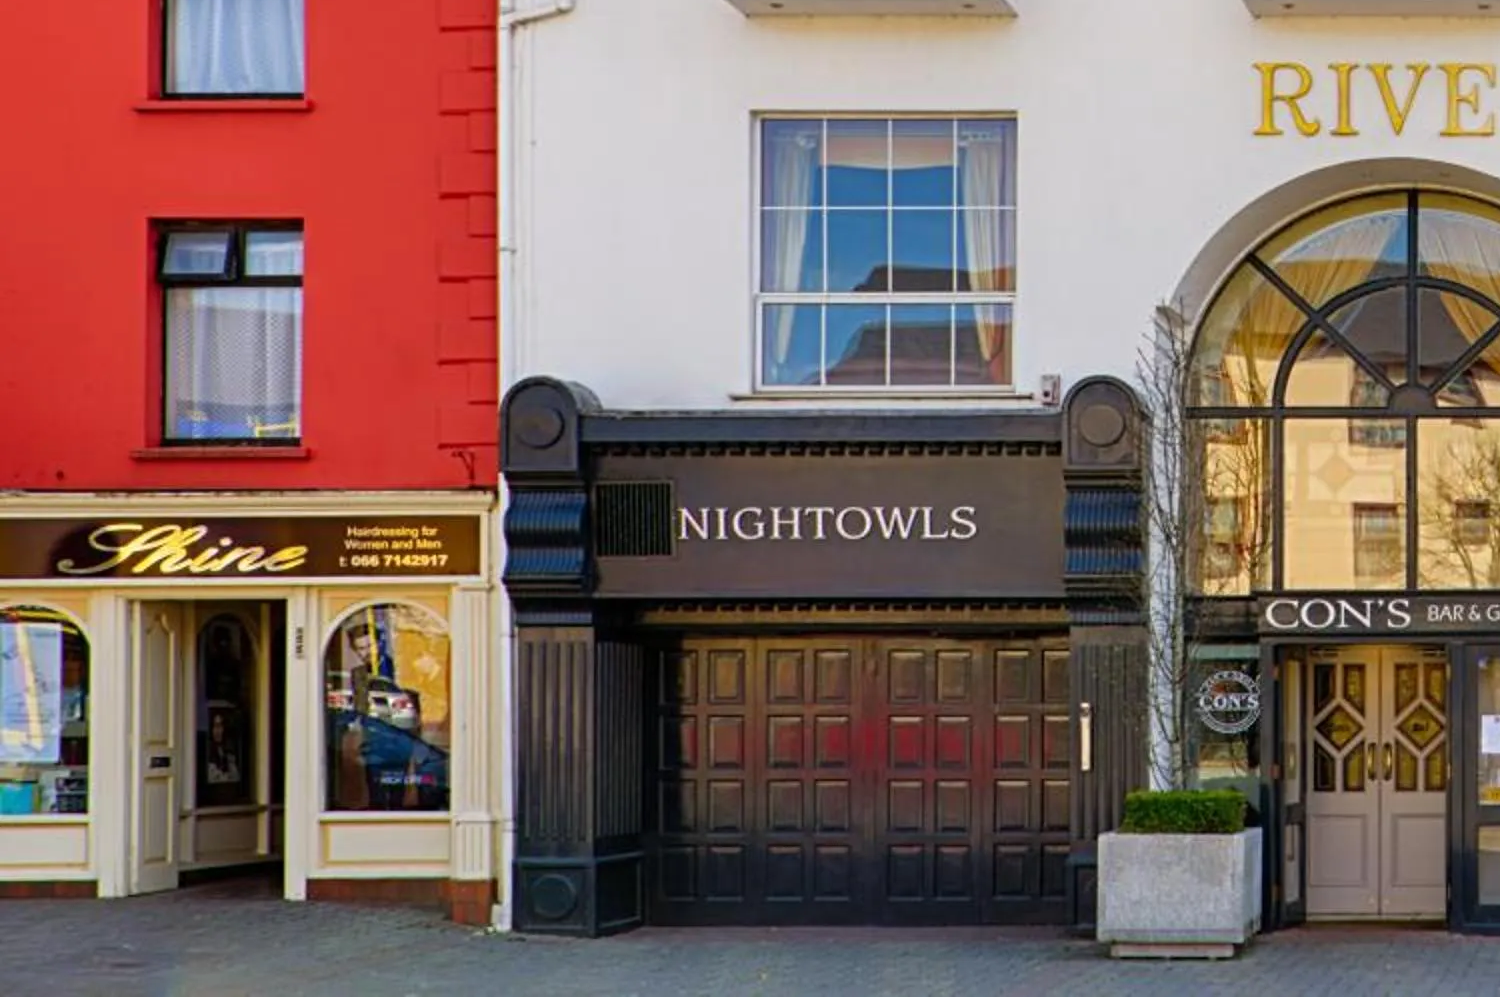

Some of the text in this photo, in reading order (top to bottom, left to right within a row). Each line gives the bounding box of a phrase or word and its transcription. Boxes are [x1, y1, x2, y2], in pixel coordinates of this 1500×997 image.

[347, 526, 438, 538] Hairdressing for
[678, 506, 978, 540] NIGHTOWLS
[58, 523, 308, 574] Shine
[344, 539, 442, 549] Women and Men
[1265, 598, 1411, 629] CON'S
[1427, 604, 1464, 622] BAR
[1468, 604, 1481, 622] &
